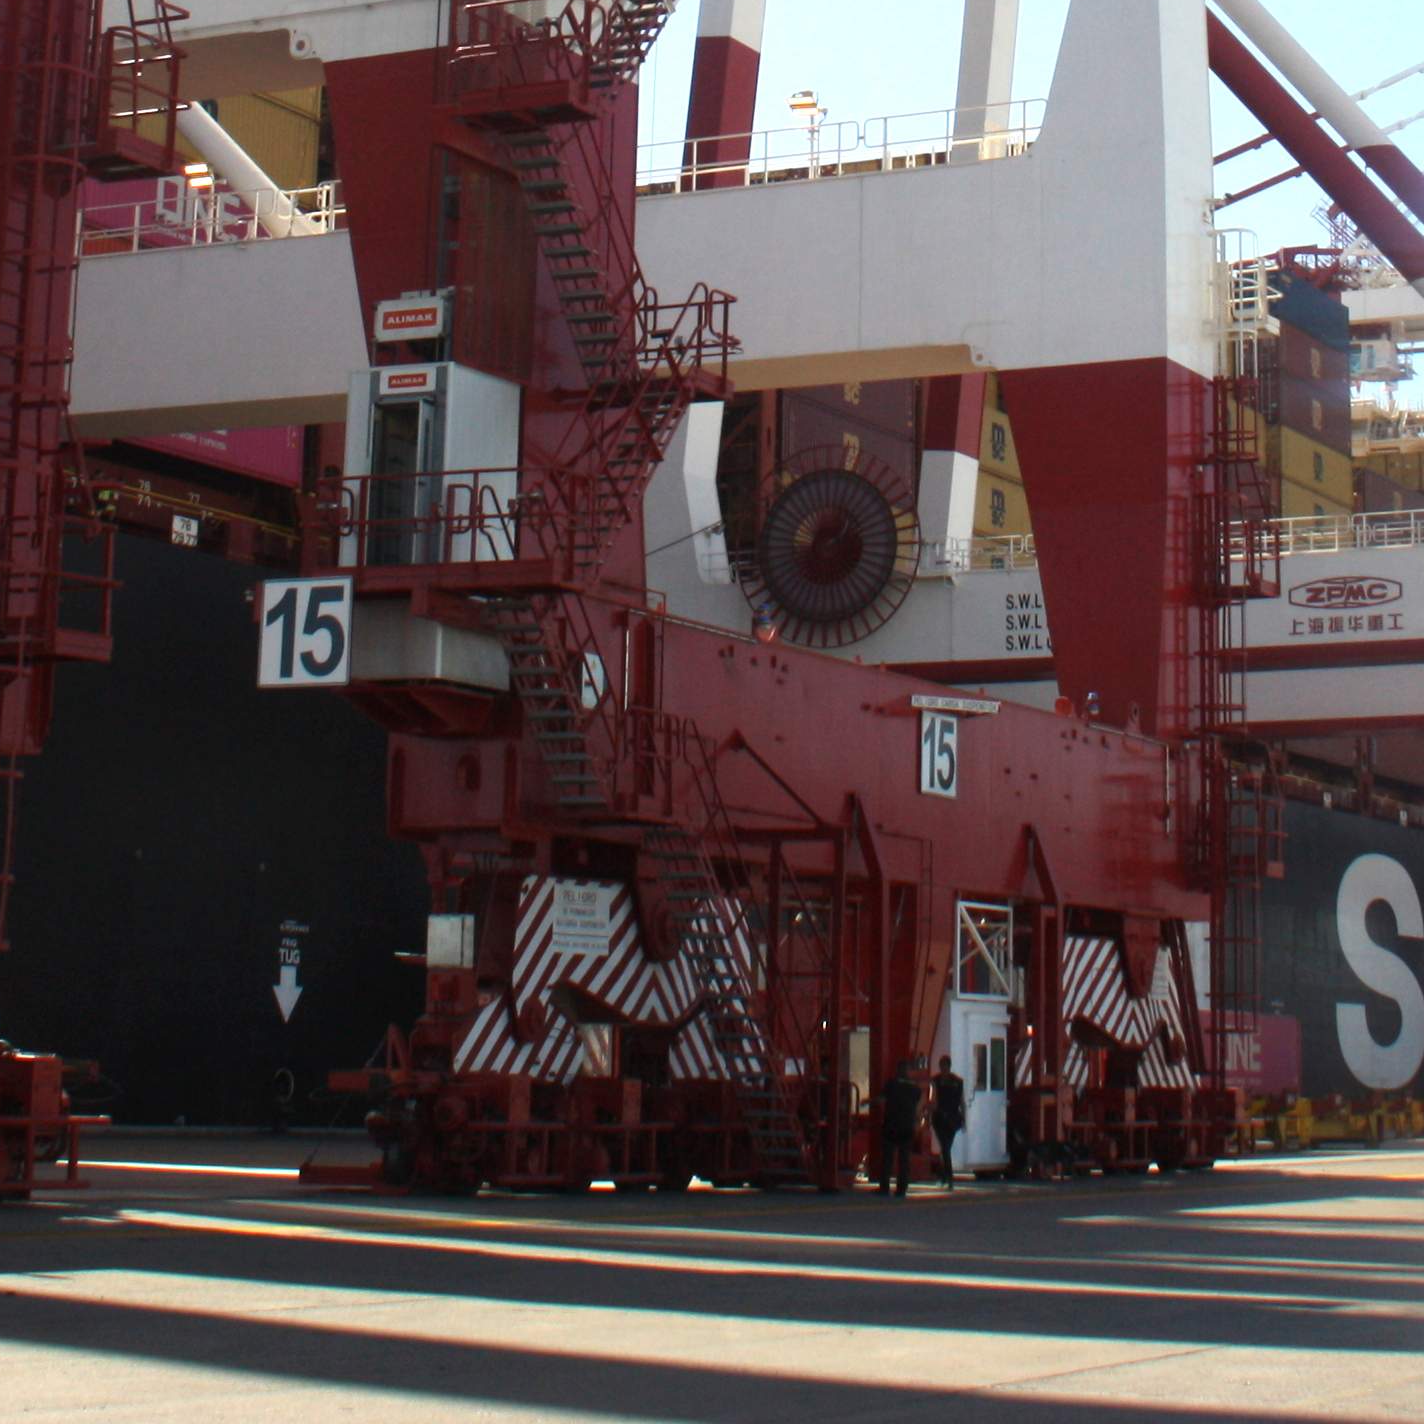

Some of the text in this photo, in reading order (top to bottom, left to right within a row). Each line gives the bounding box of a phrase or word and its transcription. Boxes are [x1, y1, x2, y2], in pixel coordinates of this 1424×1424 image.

[387, 314, 433, 325] ALIMAK
[391, 377, 425, 386] ALIMAK
[1005, 593, 1043, 610] S.W.L
[1305, 583, 1388, 604] ZPMC
[1005, 613, 1042, 631] S.W.L
[266, 585, 345, 678] 15
[1005, 634, 1044, 652] S.W.L
[923, 717, 955, 790] 15
[279, 948, 301, 964] TUG
